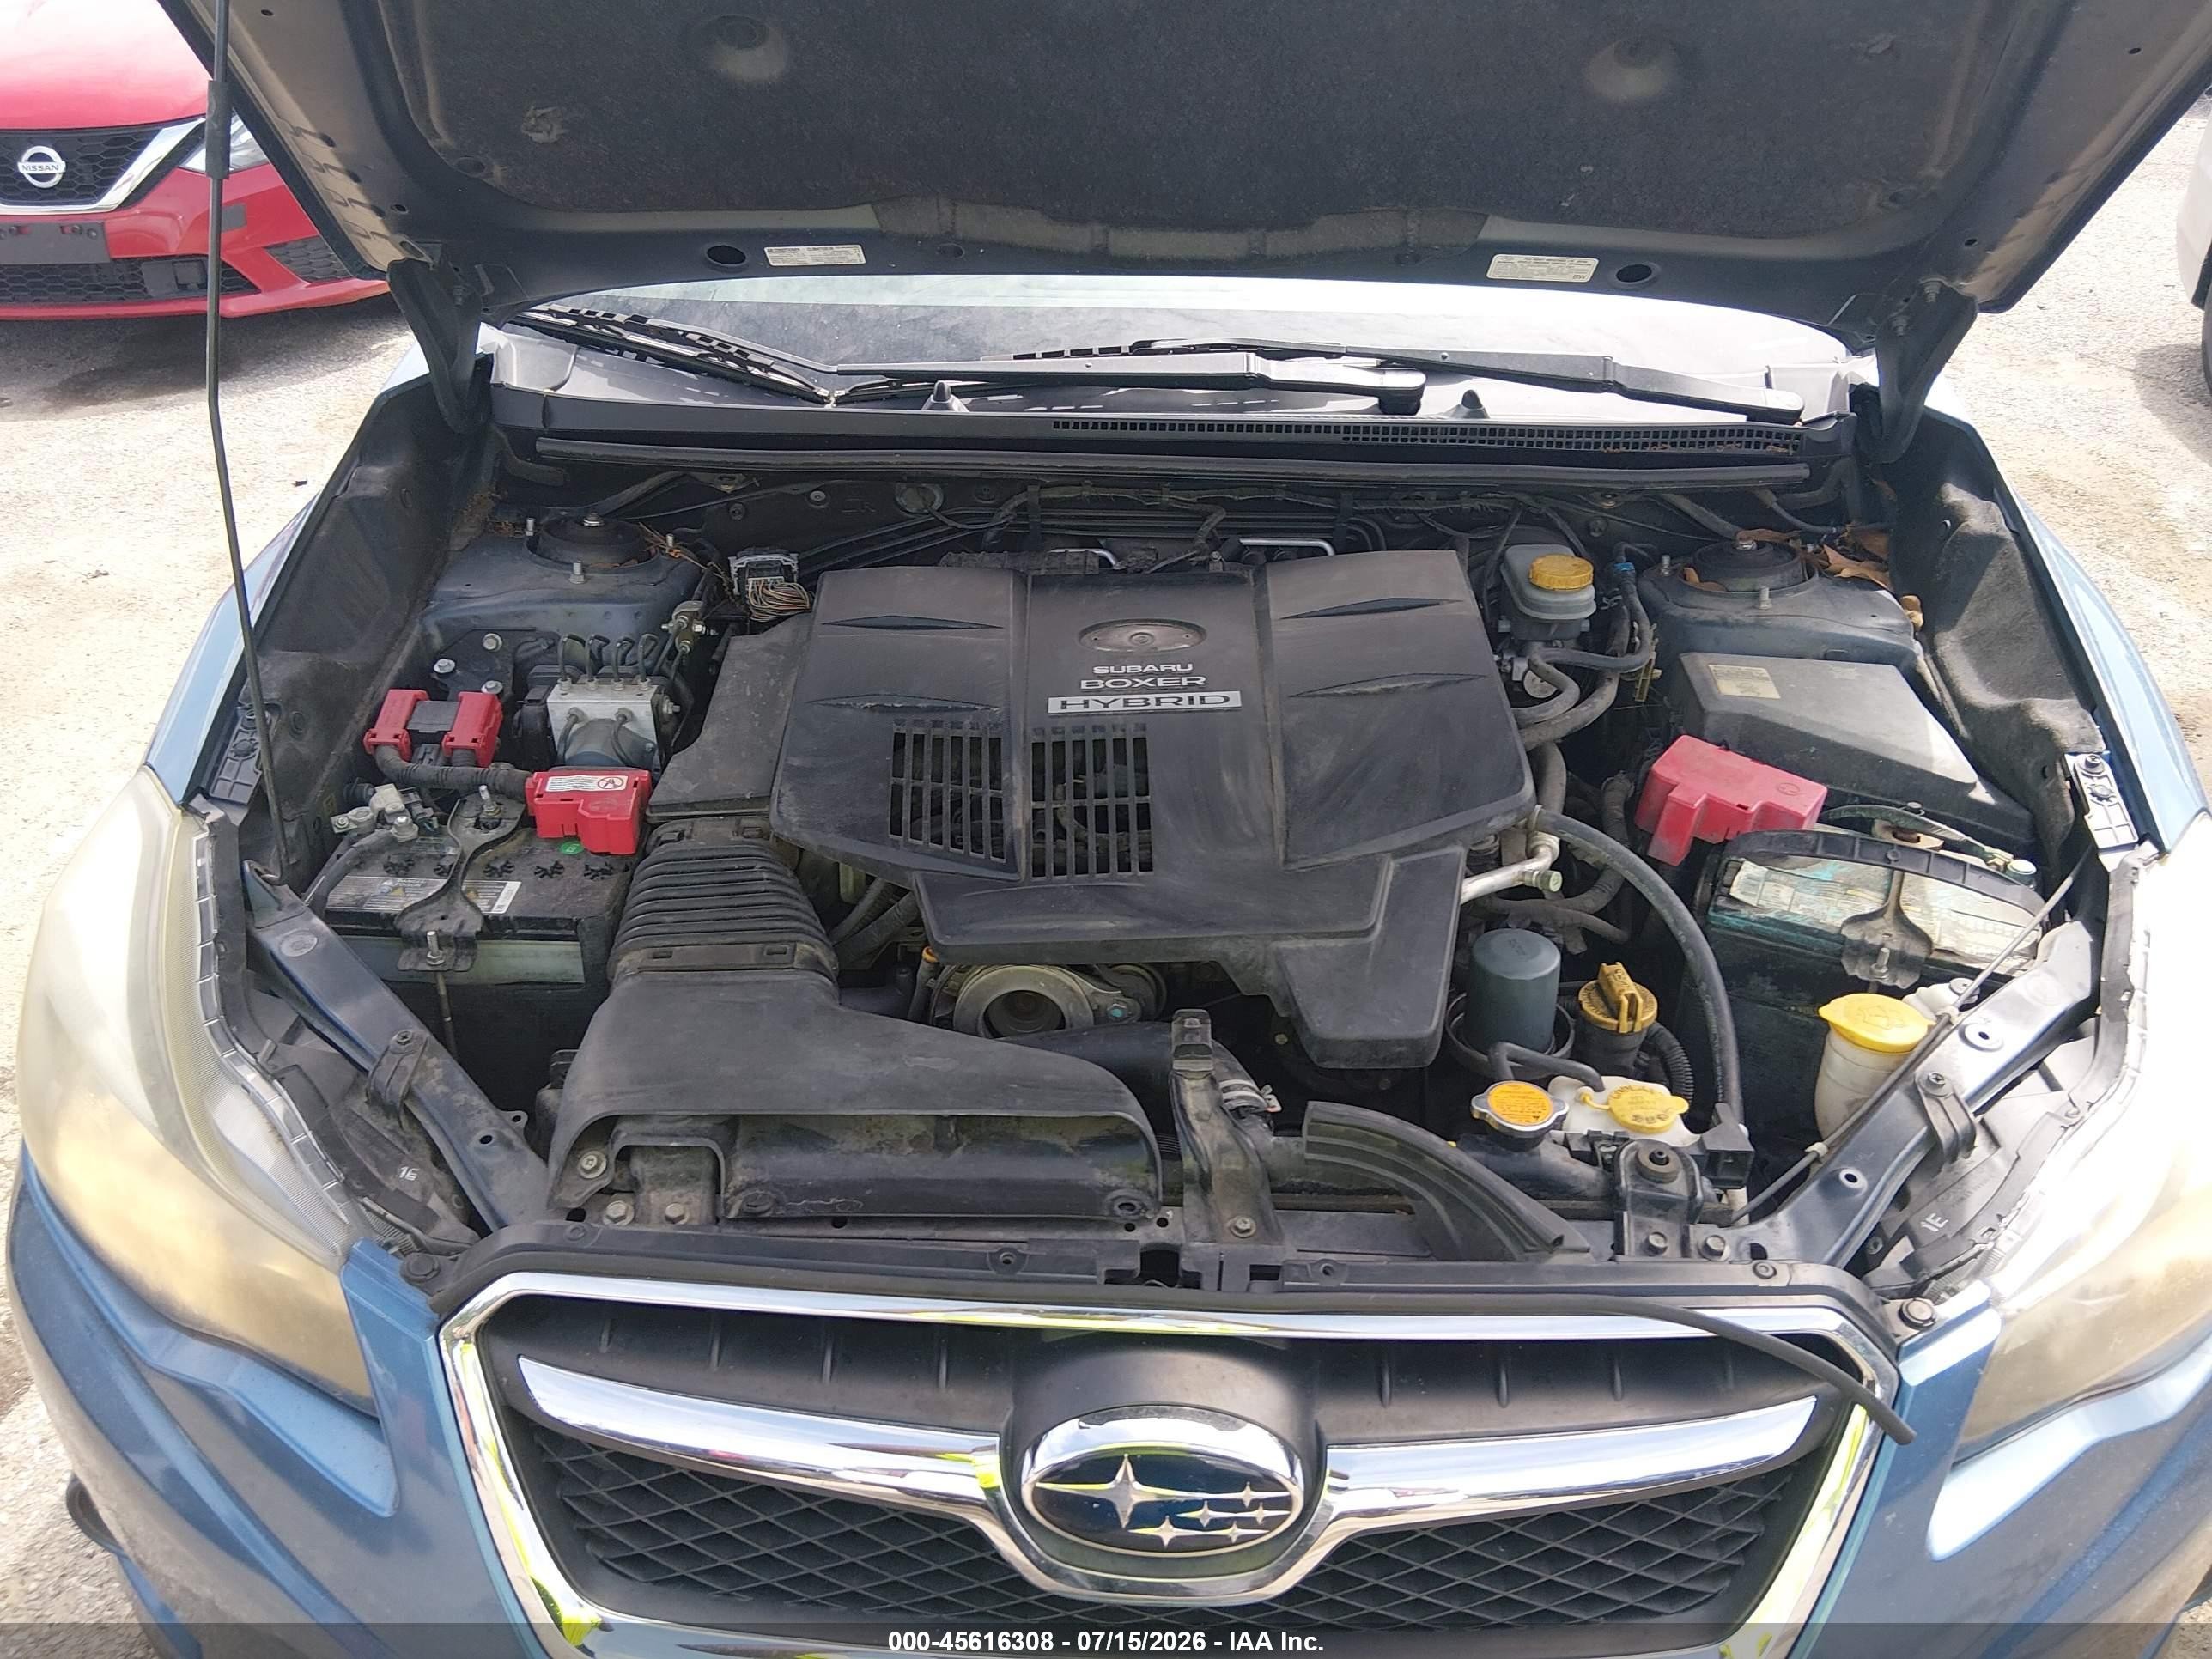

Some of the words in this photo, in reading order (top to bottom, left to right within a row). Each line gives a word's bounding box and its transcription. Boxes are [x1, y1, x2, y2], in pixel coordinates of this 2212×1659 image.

[1092, 663, 1194, 675] SUBARU
[1080, 676, 1206, 690] BOXER
[1060, 695, 1231, 709] HYBRID
